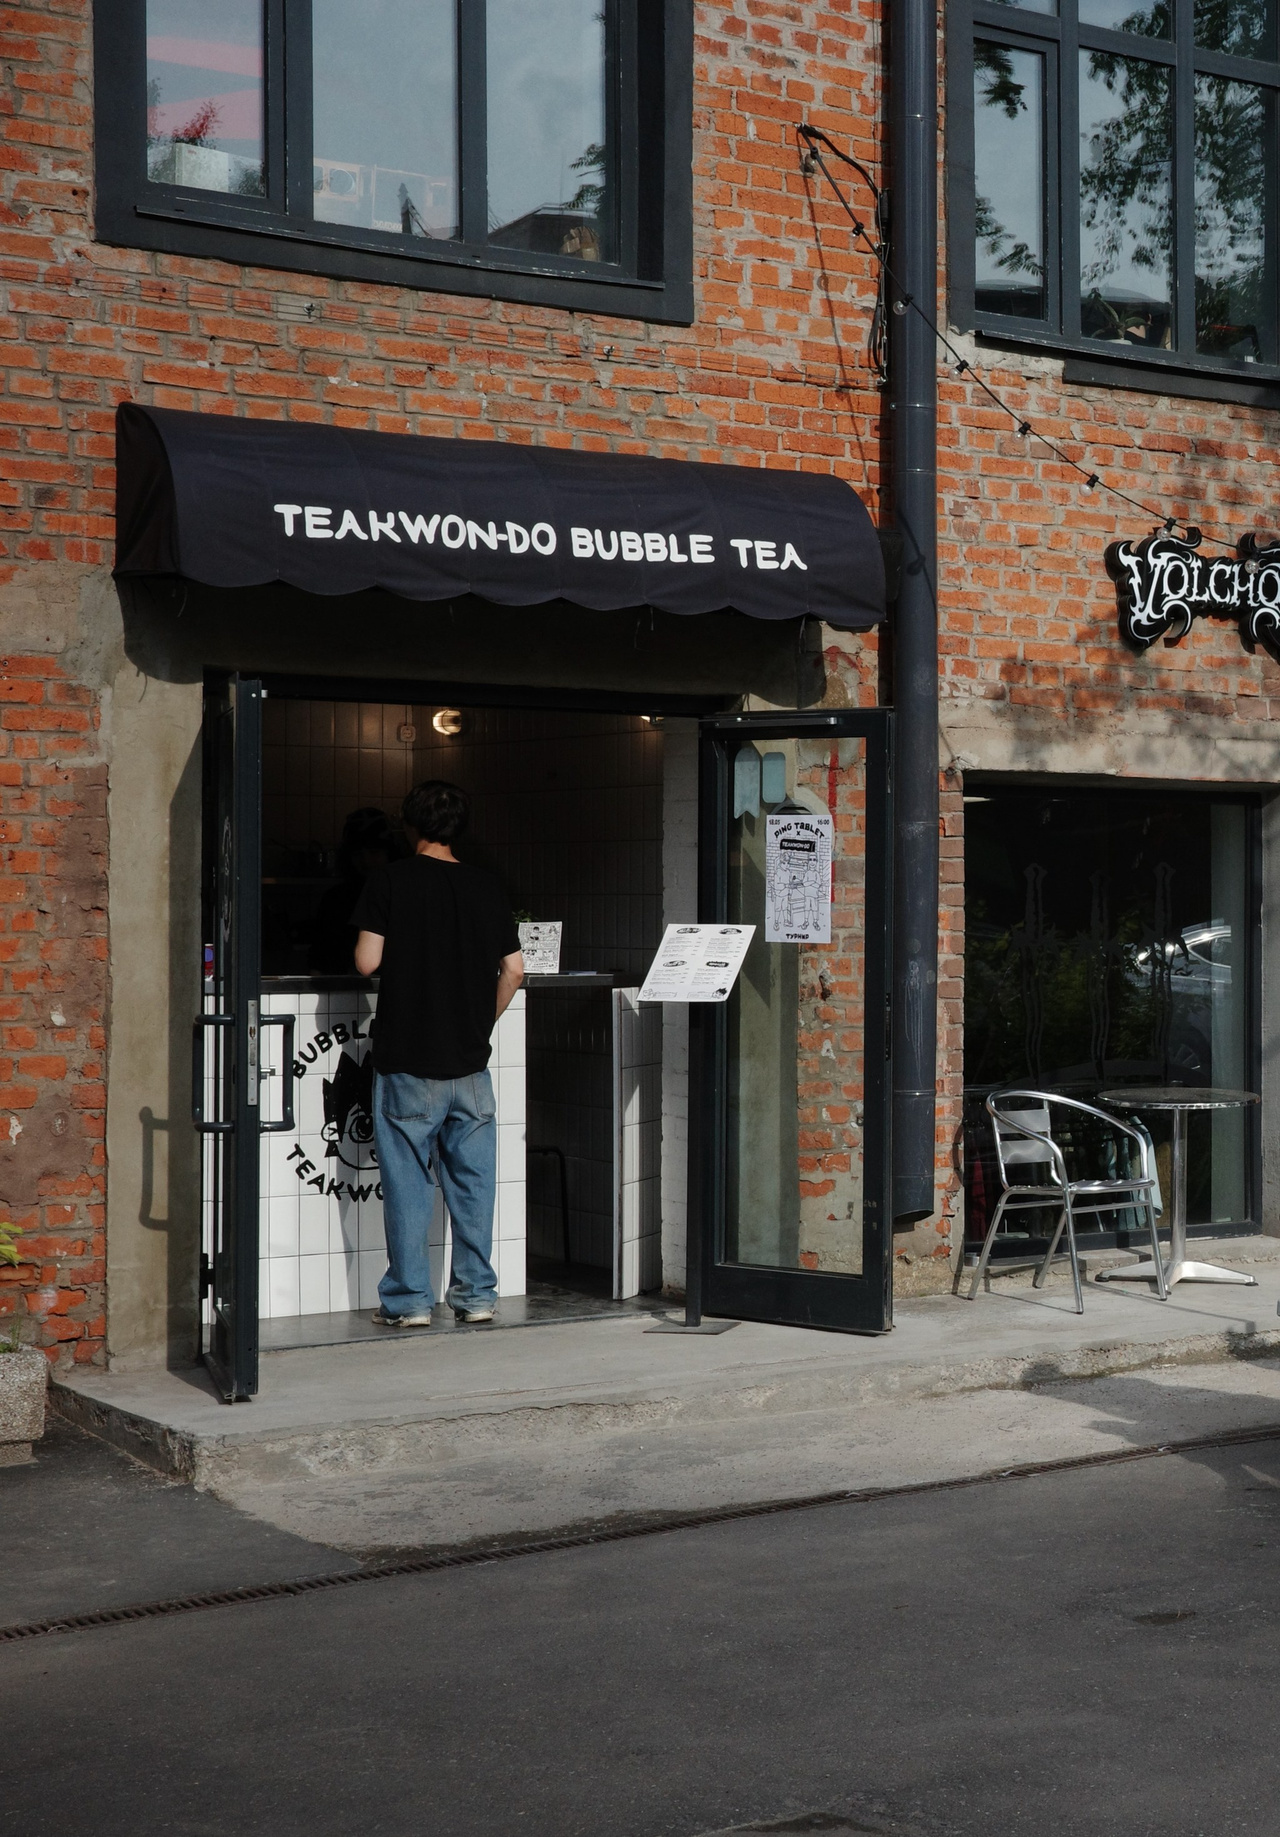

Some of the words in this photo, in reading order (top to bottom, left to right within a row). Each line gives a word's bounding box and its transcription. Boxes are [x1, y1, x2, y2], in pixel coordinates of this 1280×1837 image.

[273, 503, 557, 555] TEAKWON-DO
[571, 527, 714, 563] BUBBLE
[730, 539, 807, 570] TEA
[774, 823, 792, 838] PING
